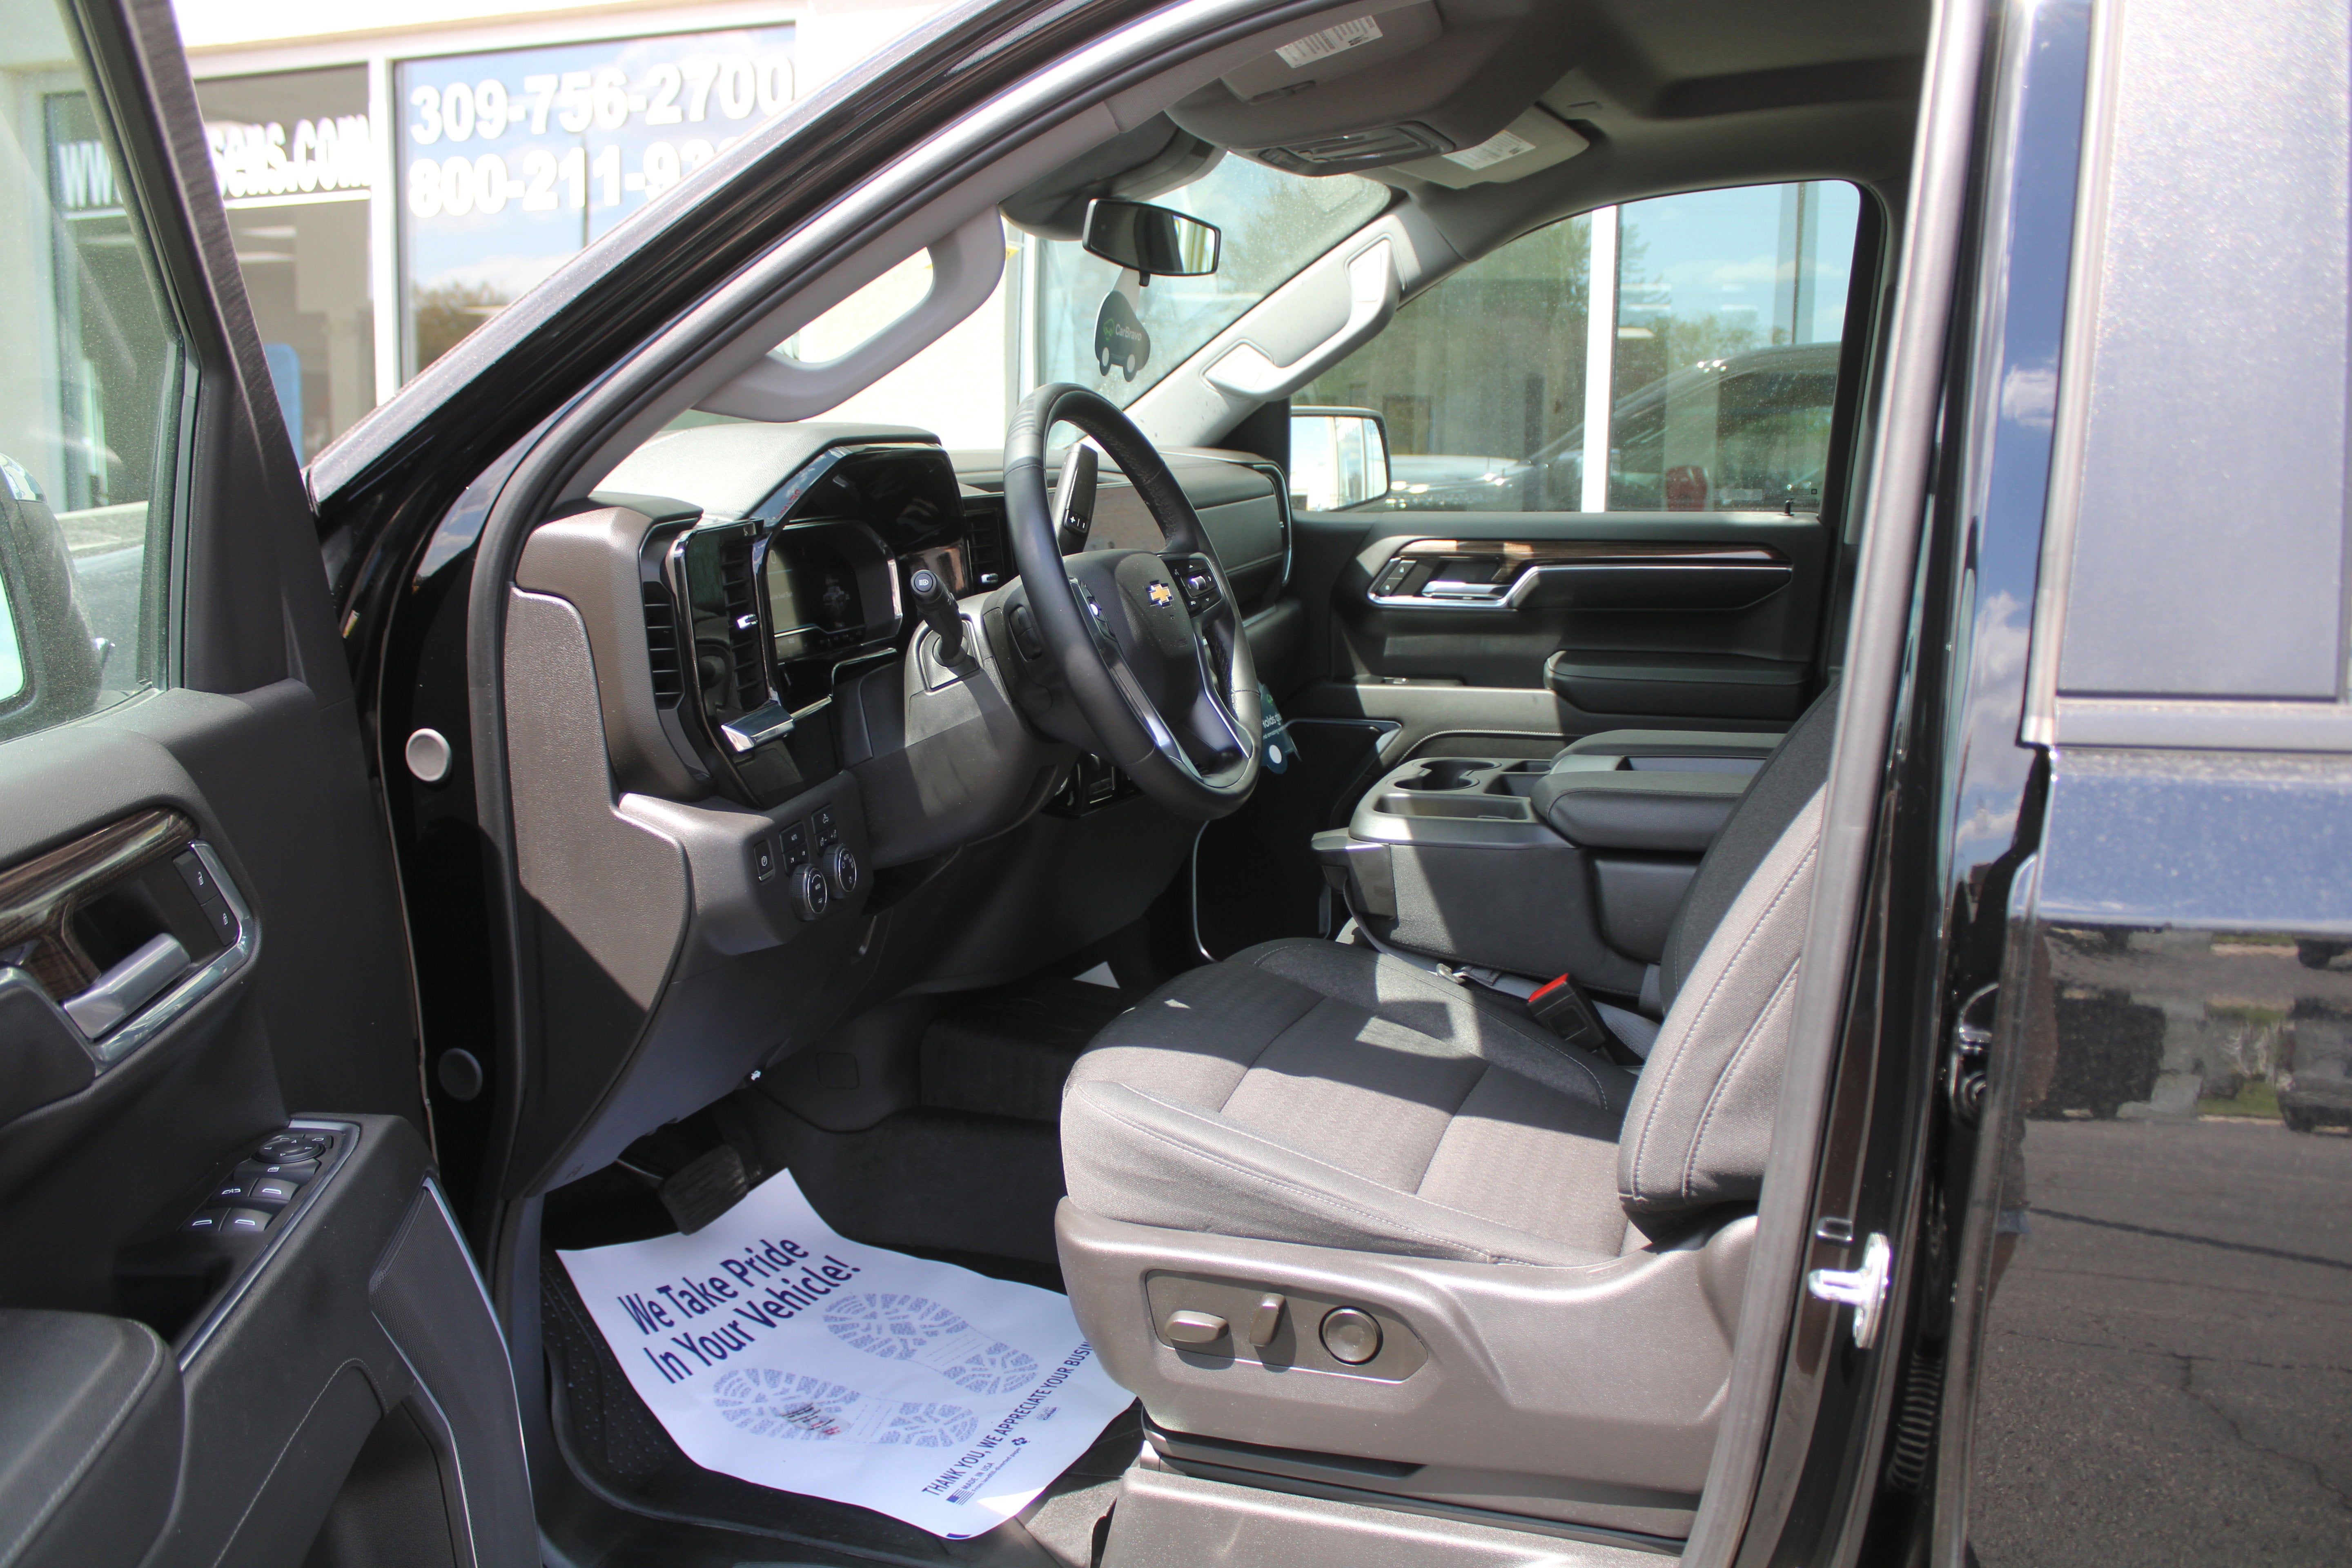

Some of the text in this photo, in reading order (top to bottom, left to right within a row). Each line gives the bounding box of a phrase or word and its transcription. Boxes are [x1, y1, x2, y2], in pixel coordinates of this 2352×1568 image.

[409, 52, 795, 144] 309-756-2700
[1116, 323, 1142, 341] CarBravo
[617, 1239, 809, 1335] We Take Pride
[643, 1255, 861, 1384] In Your Vehicle!
[922, 1468, 967, 1495] THANK
[954, 1450, 991, 1468] YOU,
[976, 1435, 1004, 1448] WE
[993, 1389, 1052, 1436] APPRECIATE
[1040, 1368, 1074, 1388] YOUR
[1063, 1341, 1093, 1367] BUSIN
[961, 1477, 979, 1490] MADE
[980, 1462, 995, 1472] USA
